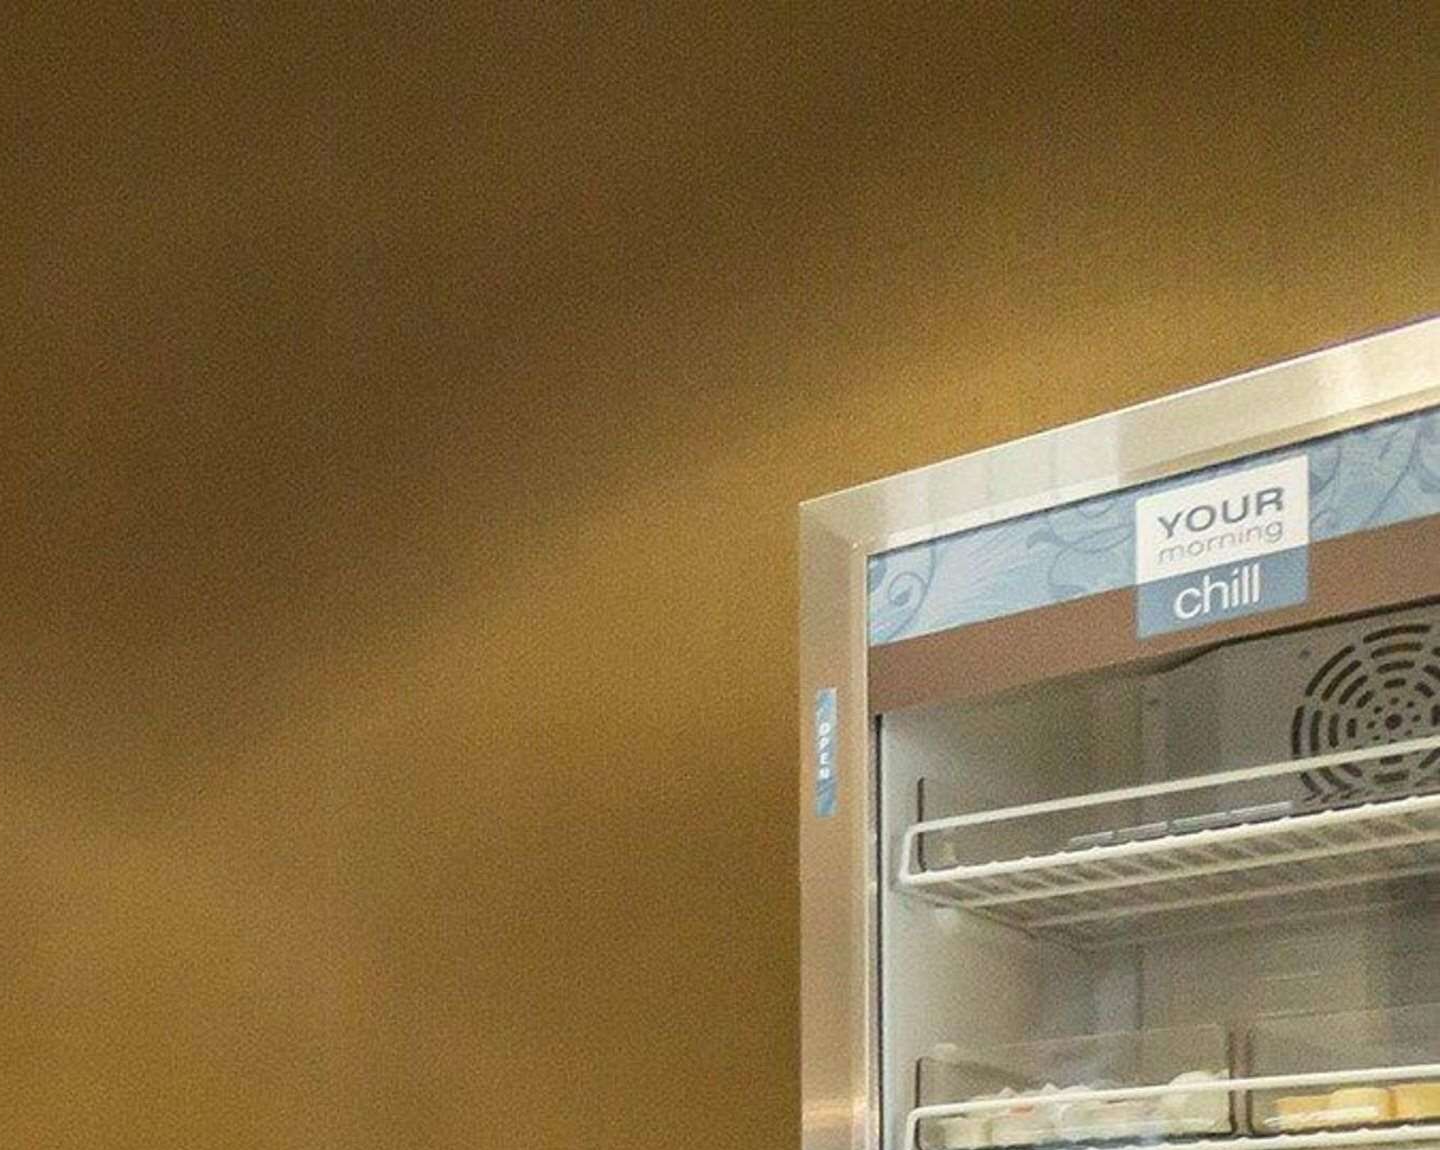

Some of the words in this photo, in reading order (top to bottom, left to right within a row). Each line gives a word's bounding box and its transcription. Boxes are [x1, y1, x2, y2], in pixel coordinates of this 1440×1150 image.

[1157, 486, 1285, 540] YOUR
[1158, 521, 1284, 564] morning
[1173, 562, 1261, 620] chill
